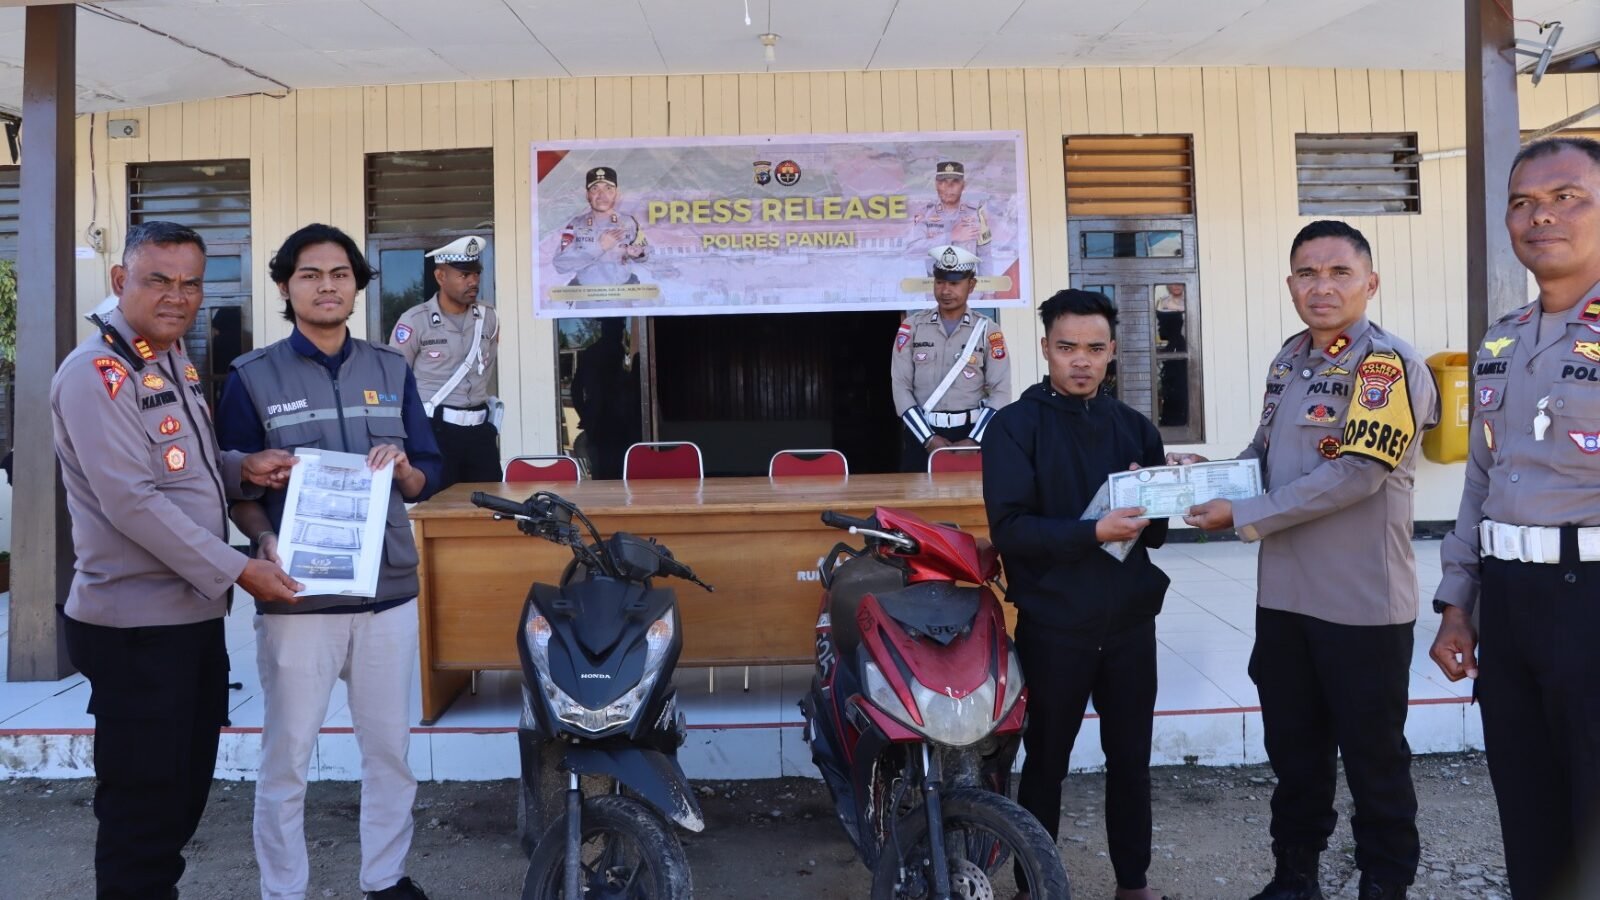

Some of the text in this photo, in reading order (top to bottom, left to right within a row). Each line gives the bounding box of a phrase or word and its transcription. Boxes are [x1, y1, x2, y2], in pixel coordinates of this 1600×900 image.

[648, 195, 908, 225] PRESS RELEASE
[703, 231, 856, 248] POLRES PANIAI
[1362, 362, 1397, 375] POLRES
[1561, 364, 1600, 382] POL
[1306, 381, 1349, 396] POLRI
[378, 393, 398, 402] PLN
[267, 398, 309, 415] UP3 NABIRE
[1342, 419, 1409, 461] OPSRES
